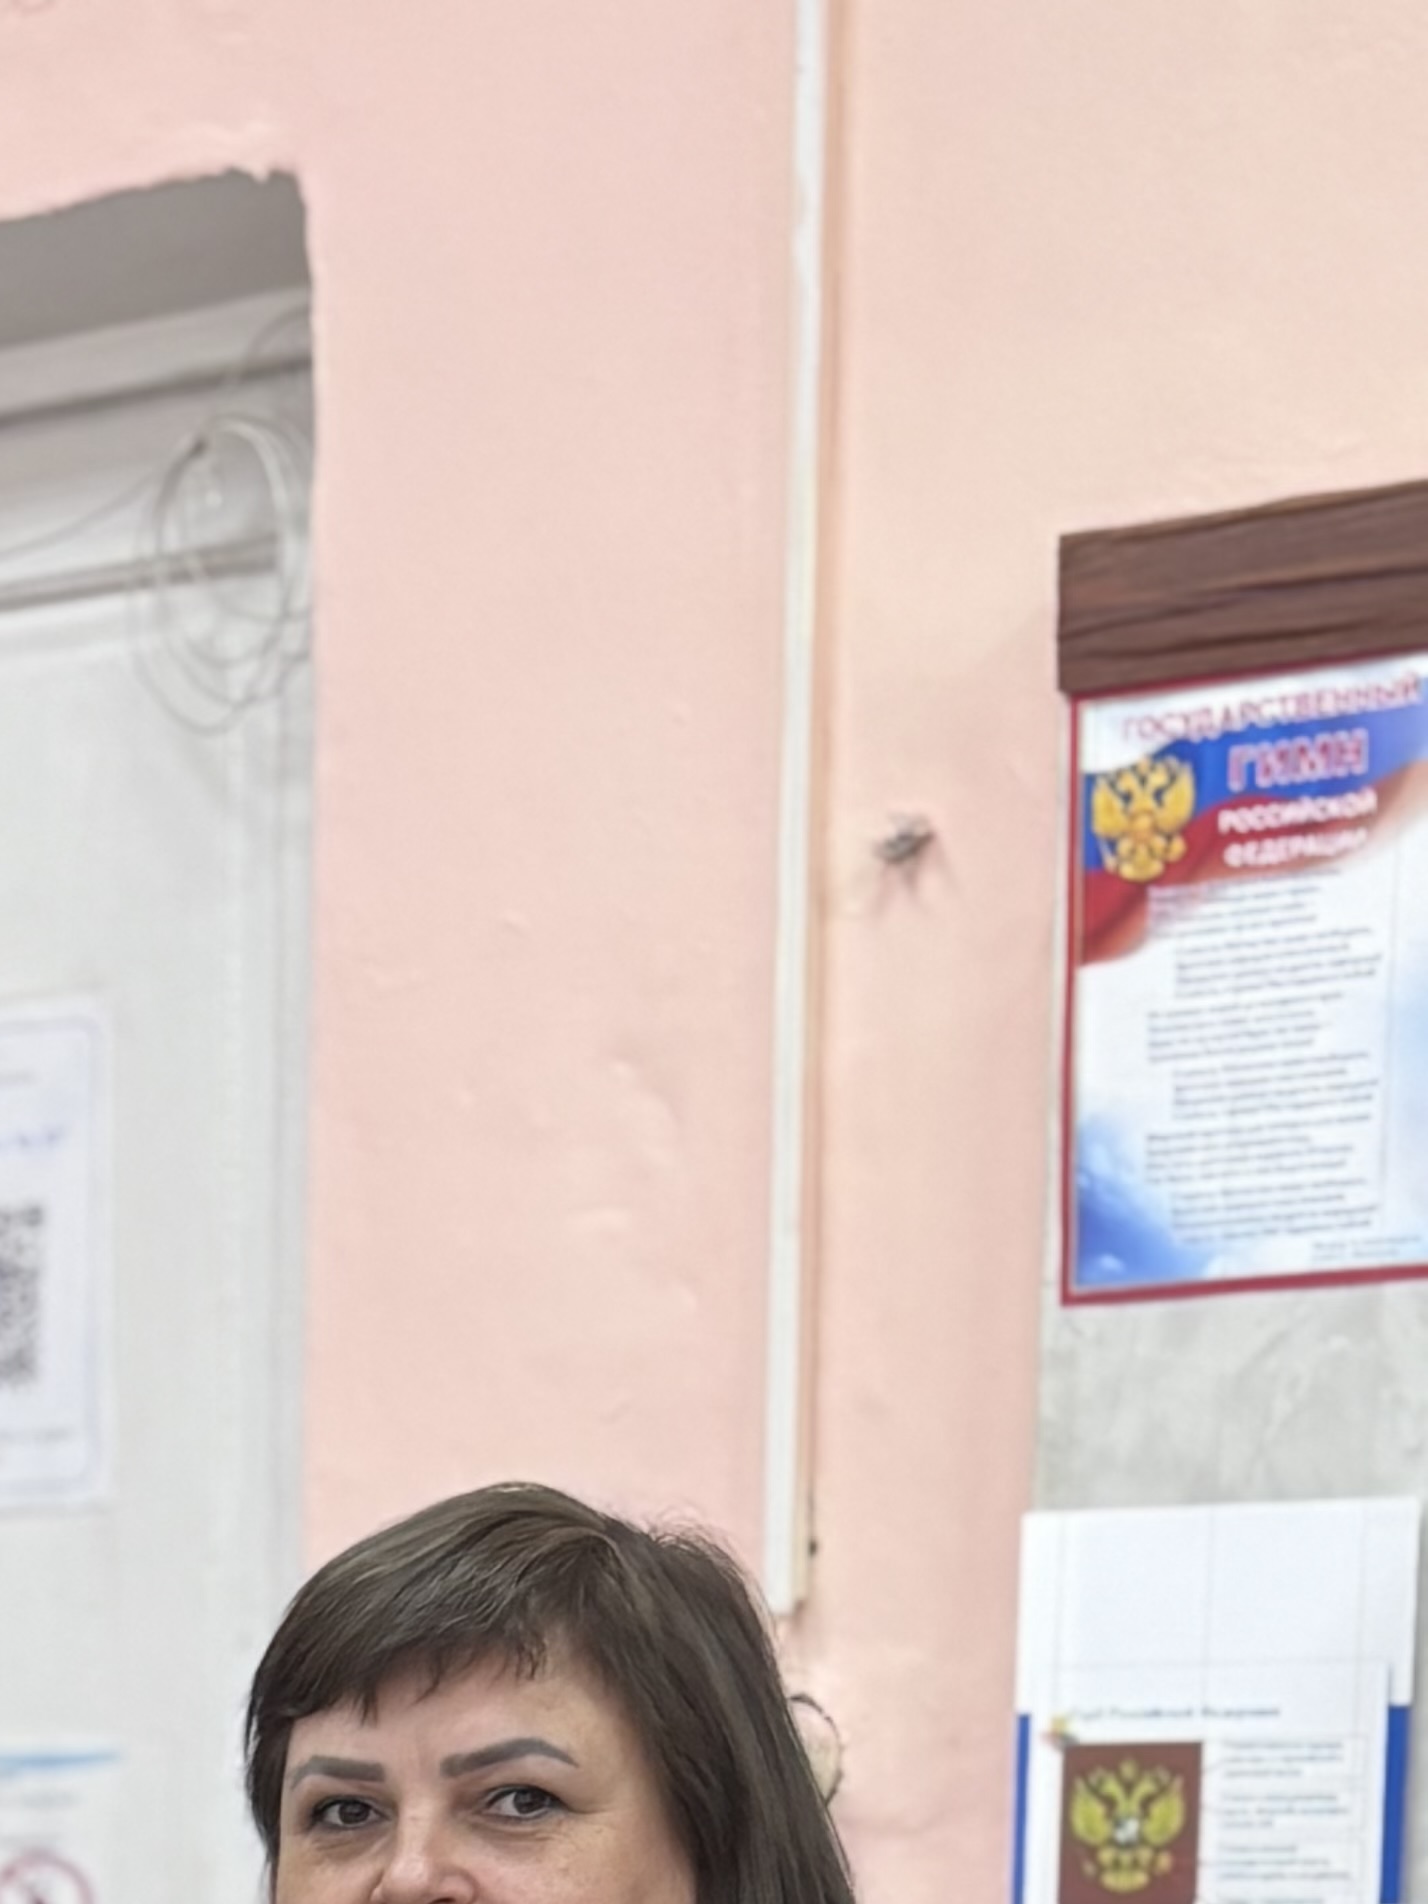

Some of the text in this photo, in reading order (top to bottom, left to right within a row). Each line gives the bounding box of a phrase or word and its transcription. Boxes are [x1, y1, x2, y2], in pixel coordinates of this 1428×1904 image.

[1228, 727, 1368, 792] ГИМН
[1218, 786, 1377, 834] РОССИЙСКОЙ
[1223, 827, 1367, 868] ФЕДЕРАЦИИ
